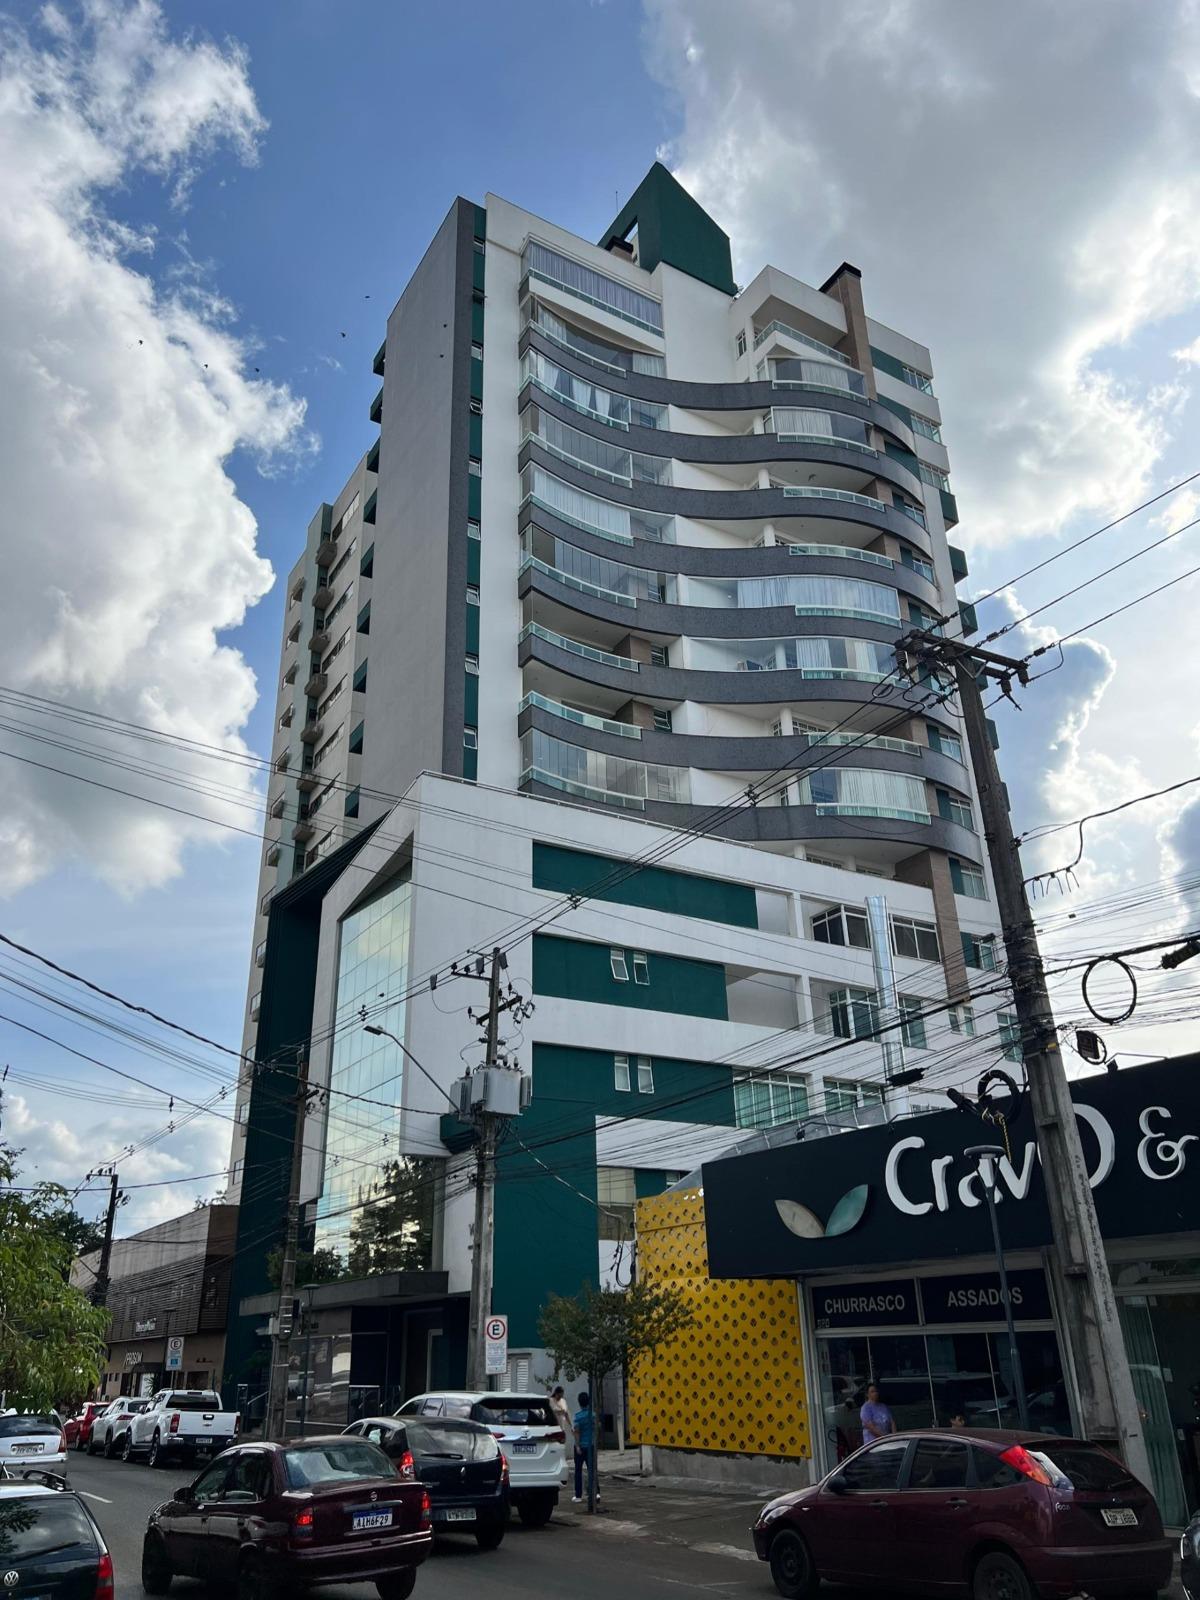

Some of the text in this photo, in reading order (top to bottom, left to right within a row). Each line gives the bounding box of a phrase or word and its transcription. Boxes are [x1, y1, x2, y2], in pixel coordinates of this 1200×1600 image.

[1137, 1106, 1199, 1180] &
[824, 1294, 905, 1314] CHURRASCO
[947, 1286, 1023, 1307] ASSADOS
[492, 1324, 500, 1336] E
